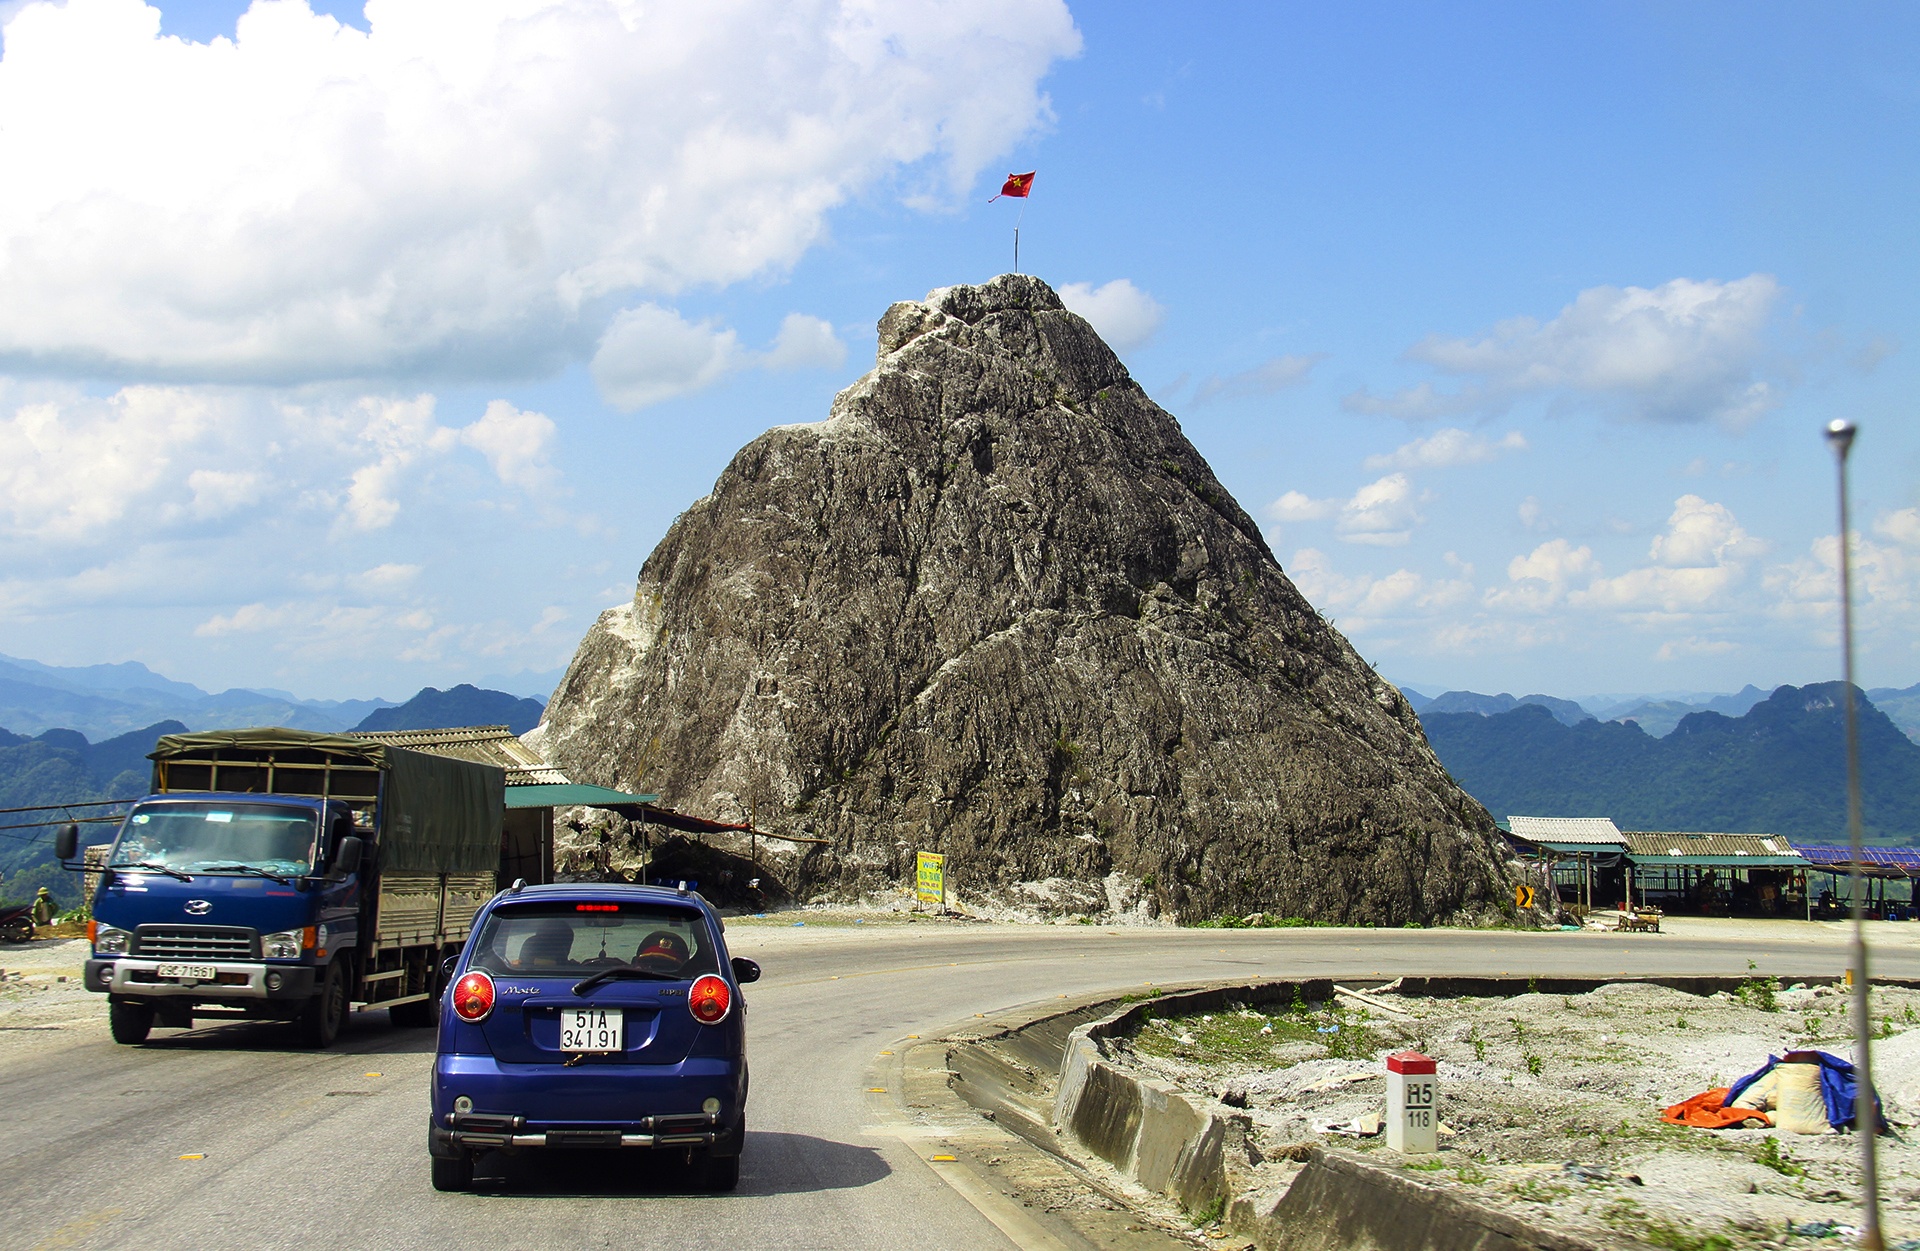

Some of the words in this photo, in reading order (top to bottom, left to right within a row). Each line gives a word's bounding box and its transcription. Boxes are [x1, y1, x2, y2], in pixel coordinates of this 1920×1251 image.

[576, 1010, 607, 1029] 51A
[563, 1029, 617, 1048] 341.91
[1407, 1083, 1433, 1104] H5
[1408, 1110, 1430, 1128] 118
